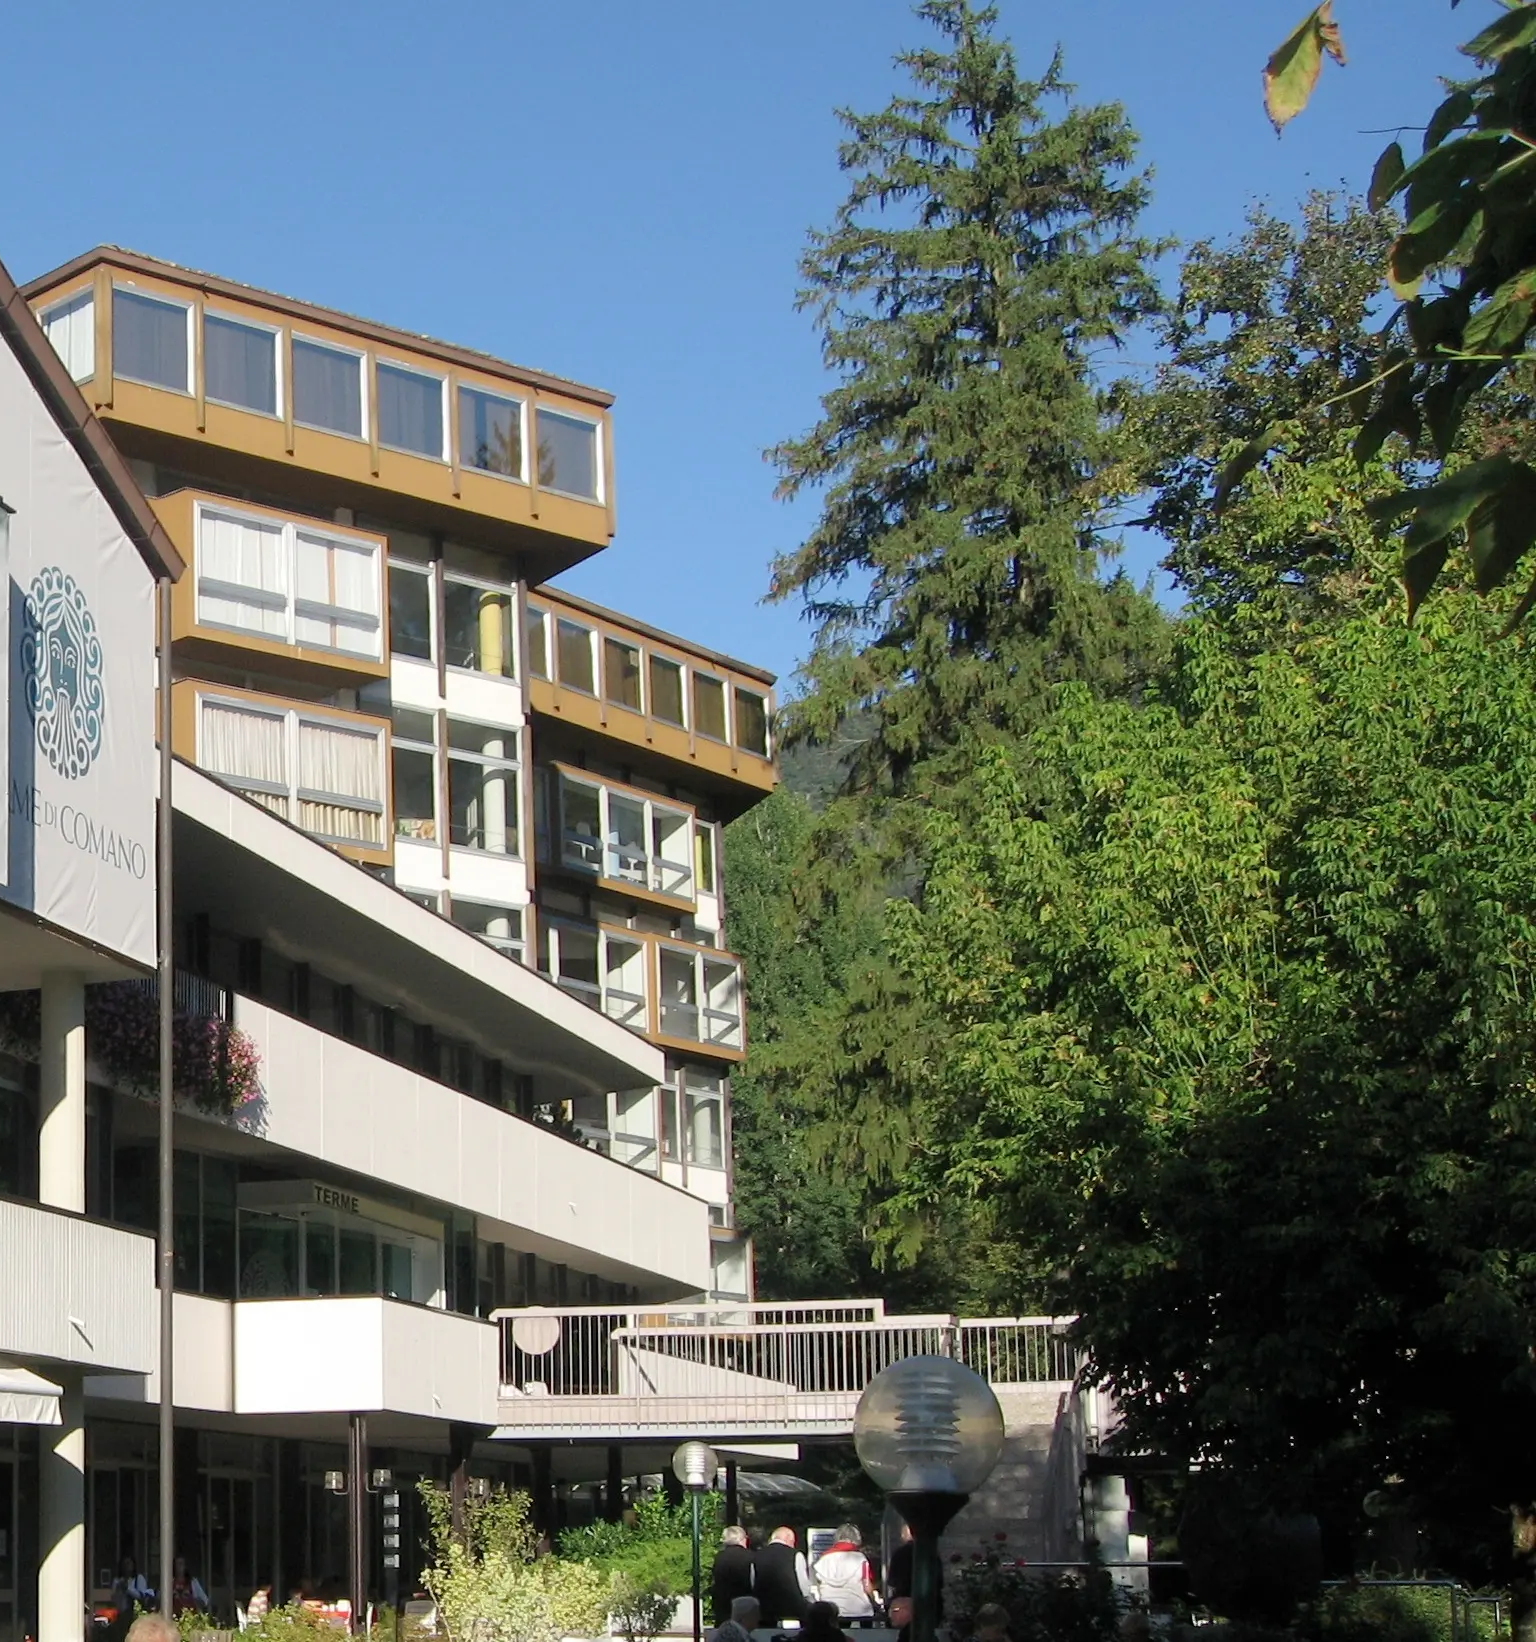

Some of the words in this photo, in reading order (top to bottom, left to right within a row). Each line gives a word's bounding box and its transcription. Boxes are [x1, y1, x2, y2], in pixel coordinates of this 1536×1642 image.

[44, 801, 57, 829] DI
[60, 805, 147, 880] COMANO
[314, 1184, 360, 1214] TERME
